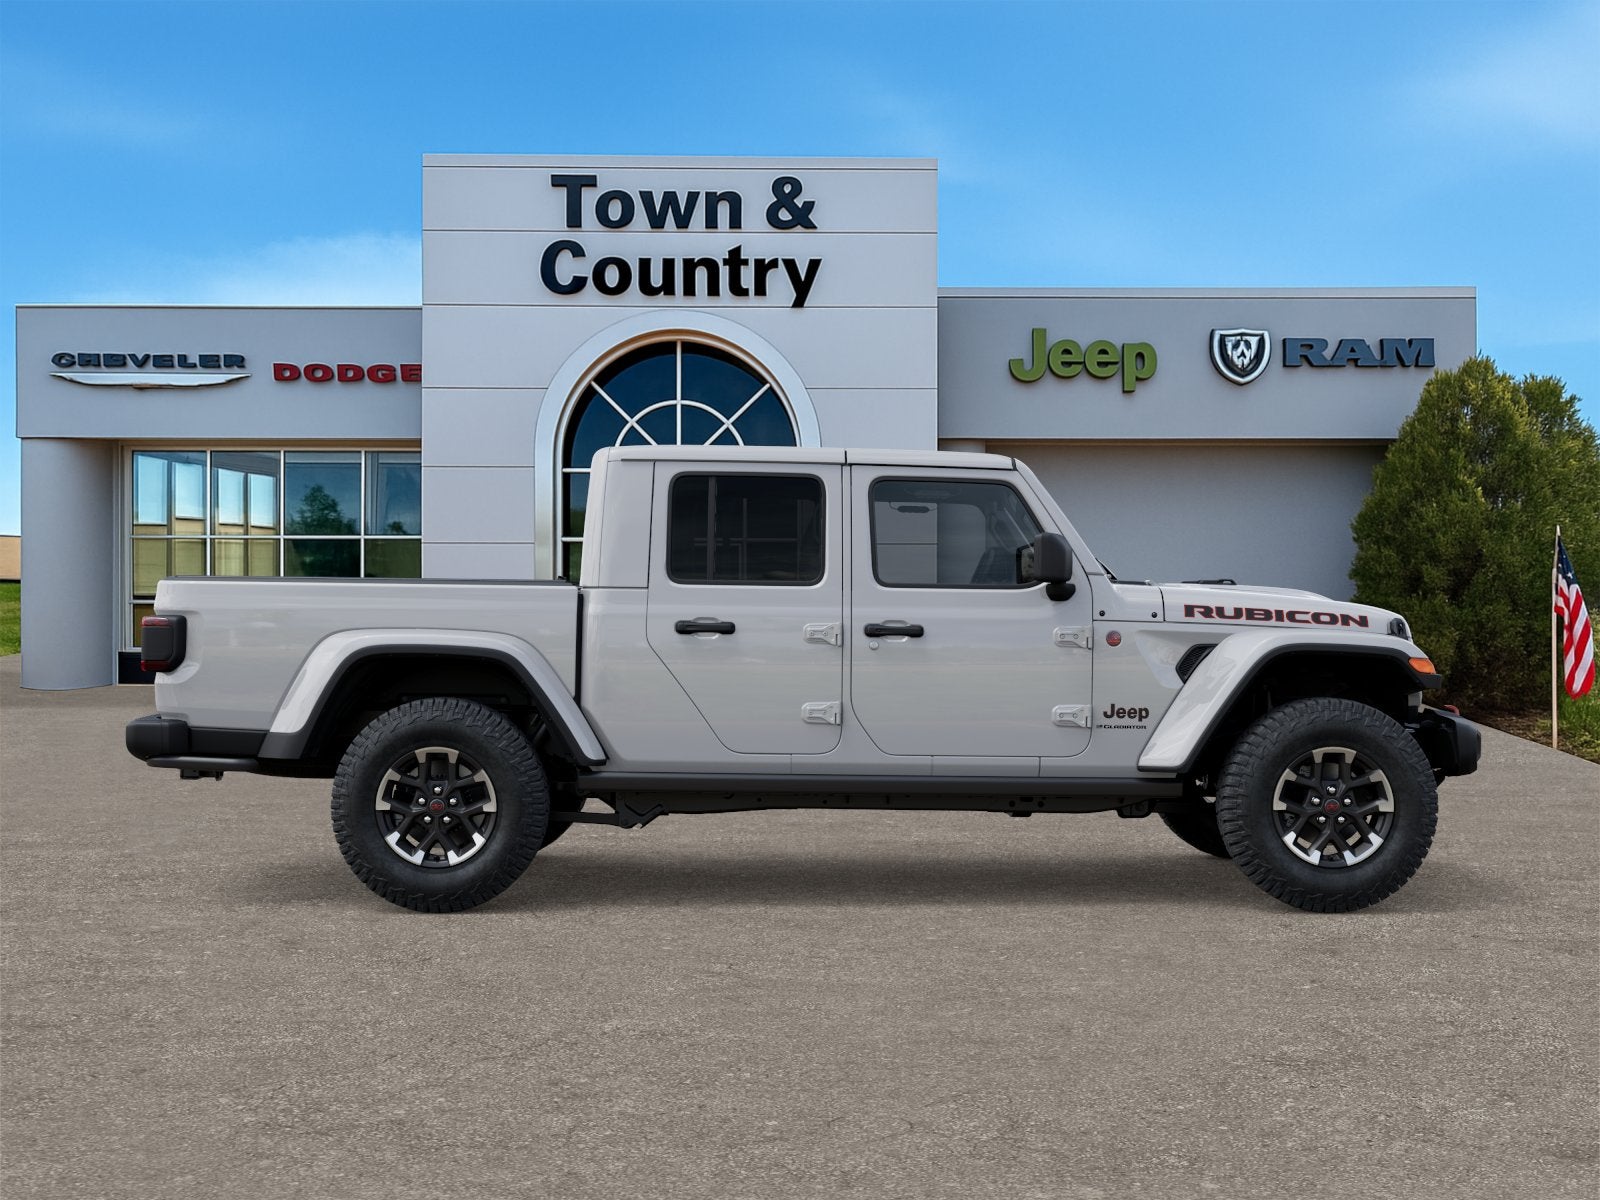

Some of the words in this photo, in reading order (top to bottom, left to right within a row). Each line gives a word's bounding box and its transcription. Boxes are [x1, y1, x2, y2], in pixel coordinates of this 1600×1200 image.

[551, 174, 742, 229] Town
[766, 176, 818, 230] &
[540, 239, 822, 308] Country
[1009, 327, 1158, 393] Jeep
[1282, 337, 1436, 368] RAM
[273, 363, 422, 383] DODGE
[1184, 604, 1369, 628] RUBICON
[1103, 703, 1150, 722] Jeep
